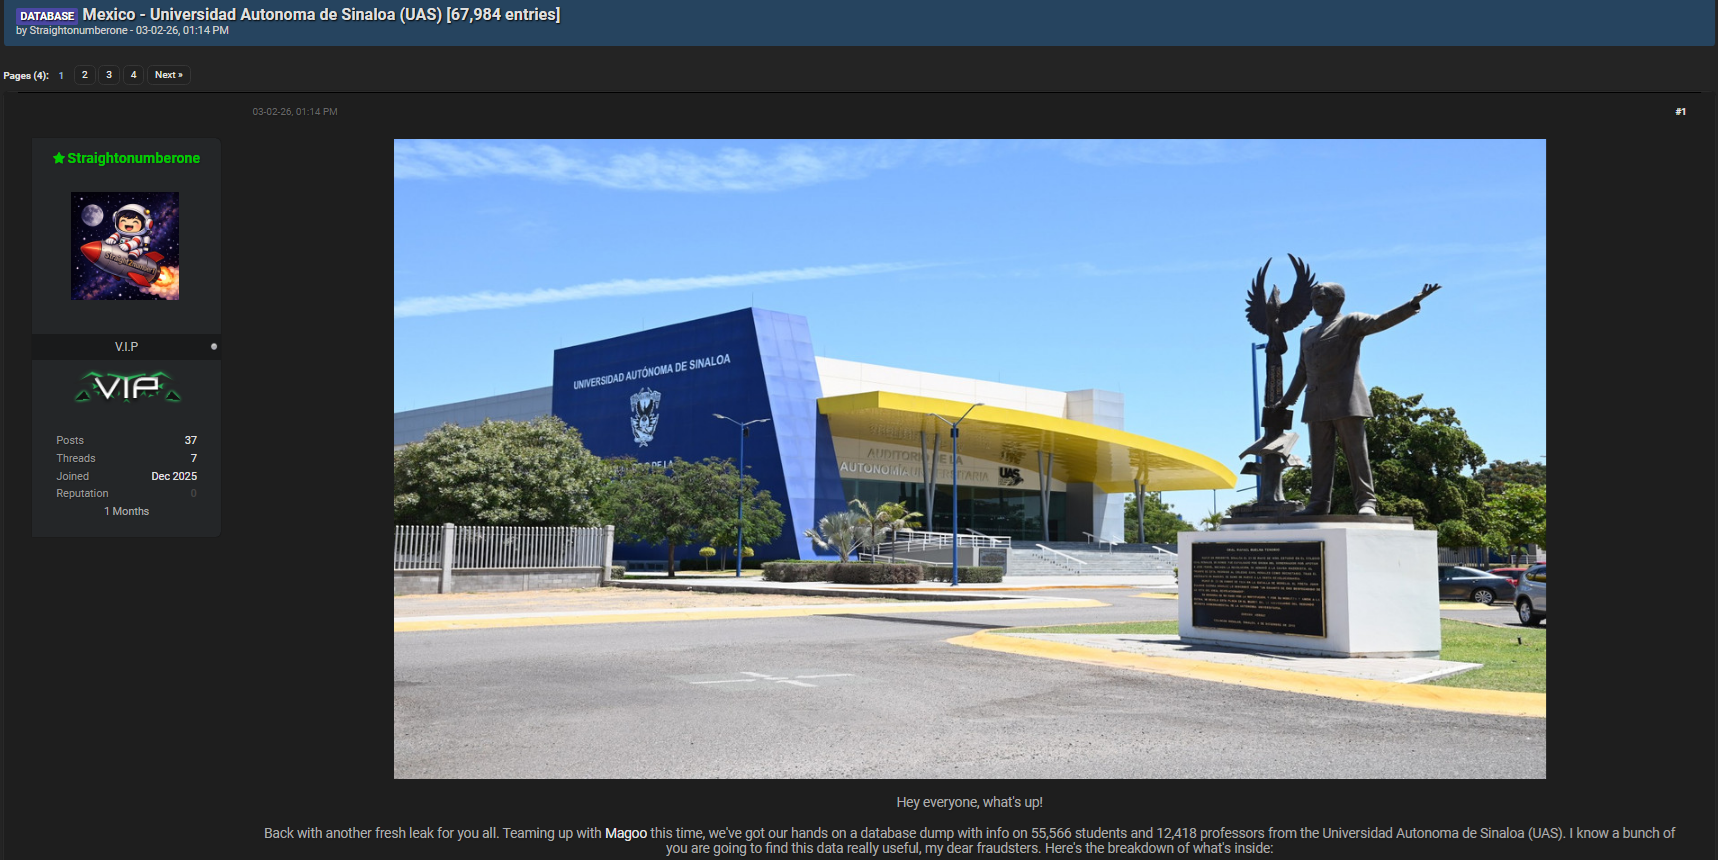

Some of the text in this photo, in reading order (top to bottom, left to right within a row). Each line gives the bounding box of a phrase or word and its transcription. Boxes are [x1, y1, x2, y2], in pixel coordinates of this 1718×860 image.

[20, 11, 75, 22] DATABASE
[82, 6, 136, 21] Mexico
[149, 6, 237, 21] Universidad
[239, 7, 316, 21] Autonoma
[319, 7, 338, 21] de
[340, 6, 396, 21] Sinaloa
[399, 6, 443, 25] (UAS)
[446, 6, 502, 24] [67,984
[504, 6, 561, 24] entries]
[15, 25, 28, 37] by
[29, 25, 129, 37] Straightonumberone
[135, 25, 181, 37] 03-02-26,
[182, 25, 211, 35] 01:14
[212, 25, 230, 35] PM
[2, 70, 50, 82] Pages (4):
[58, 71, 64, 80] 1
[81, 70, 89, 79] 2
[105, 70, 113, 79] 3
[129, 70, 138, 79] 4
[154, 70, 177, 79] Next
[252, 107, 338, 118] 03-02-26, 01:14 PM
[1674, 107, 1687, 116] #1
[67, 151, 201, 167] Straightonumberone
[114, 341, 139, 352] V.I.P
[573, 353, 731, 390] UNIVERSIDAD AUTÓNOMA DE SINALOA
[94, 376, 159, 400] VIP
[56, 435, 85, 445] Posts
[184, 435, 198, 445] 37
[55, 453, 97, 463] Threads
[189, 453, 198, 463] 7
[55, 471, 90, 481] Joined
[151, 471, 198, 481] Dec 2025
[999, 467, 1021, 479] UAS
[56, 488, 109, 500] Reputation
[190, 488, 198, 498] 0
[103, 506, 150, 516] 1 Months
[896, 795, 1044, 811] Hey everyone, what's up!
[264, 826, 1677, 842] Back with another fresh leak for you all. Teaming up with Magoo this time, we've got our hands on a database dump with info on 55,566 students and 12,418 professors from the Universidad Autonoma de Sinaloa (UAS). I know a bunch of
[665, 841, 1274, 857] you are going to find this data really useful, my dear fraudsters. Here's the breakdown of what's inside:
